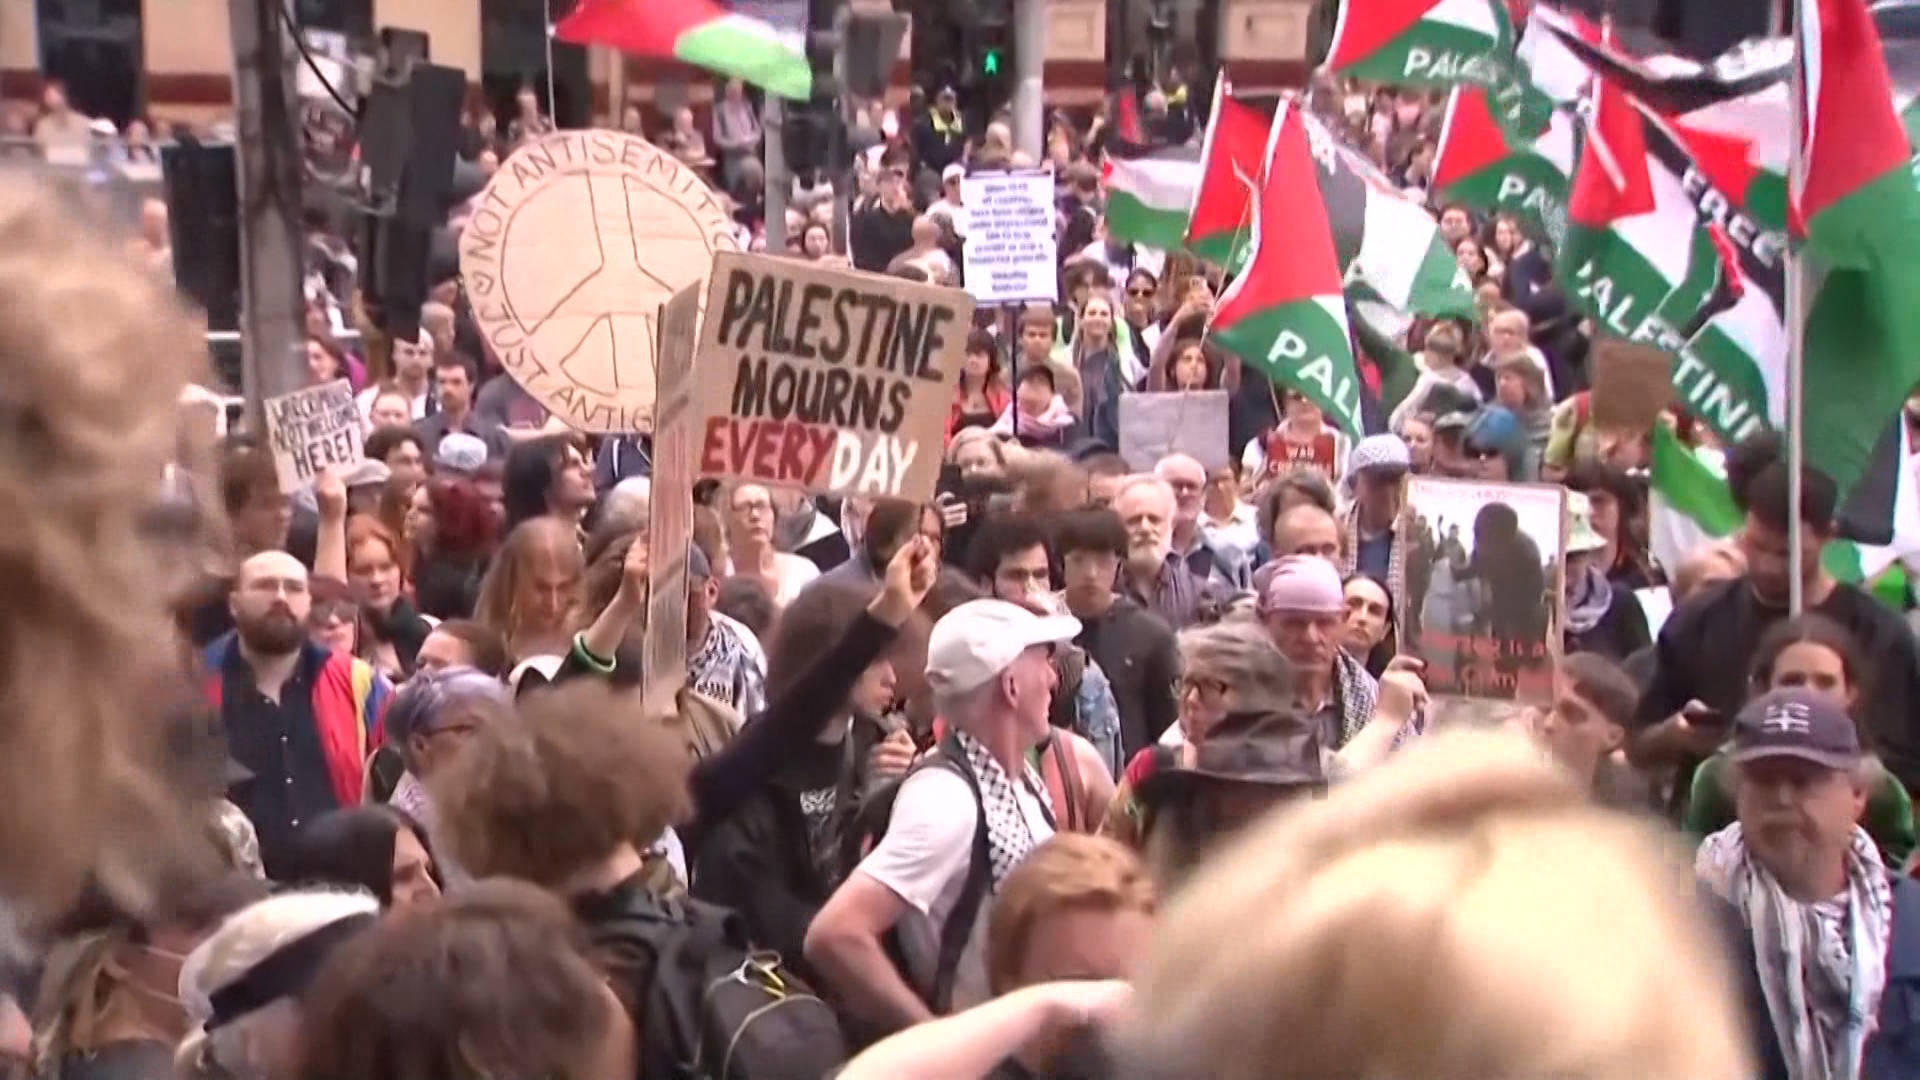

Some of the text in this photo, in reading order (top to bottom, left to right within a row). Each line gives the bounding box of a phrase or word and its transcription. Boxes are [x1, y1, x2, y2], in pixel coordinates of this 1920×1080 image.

[467, 185, 510, 262] NOT
[479, 301, 548, 385] JUST
[718, 268, 955, 382] PALESTINE
[731, 353, 913, 433] MOURNS
[292, 428, 356, 480] HERE!
